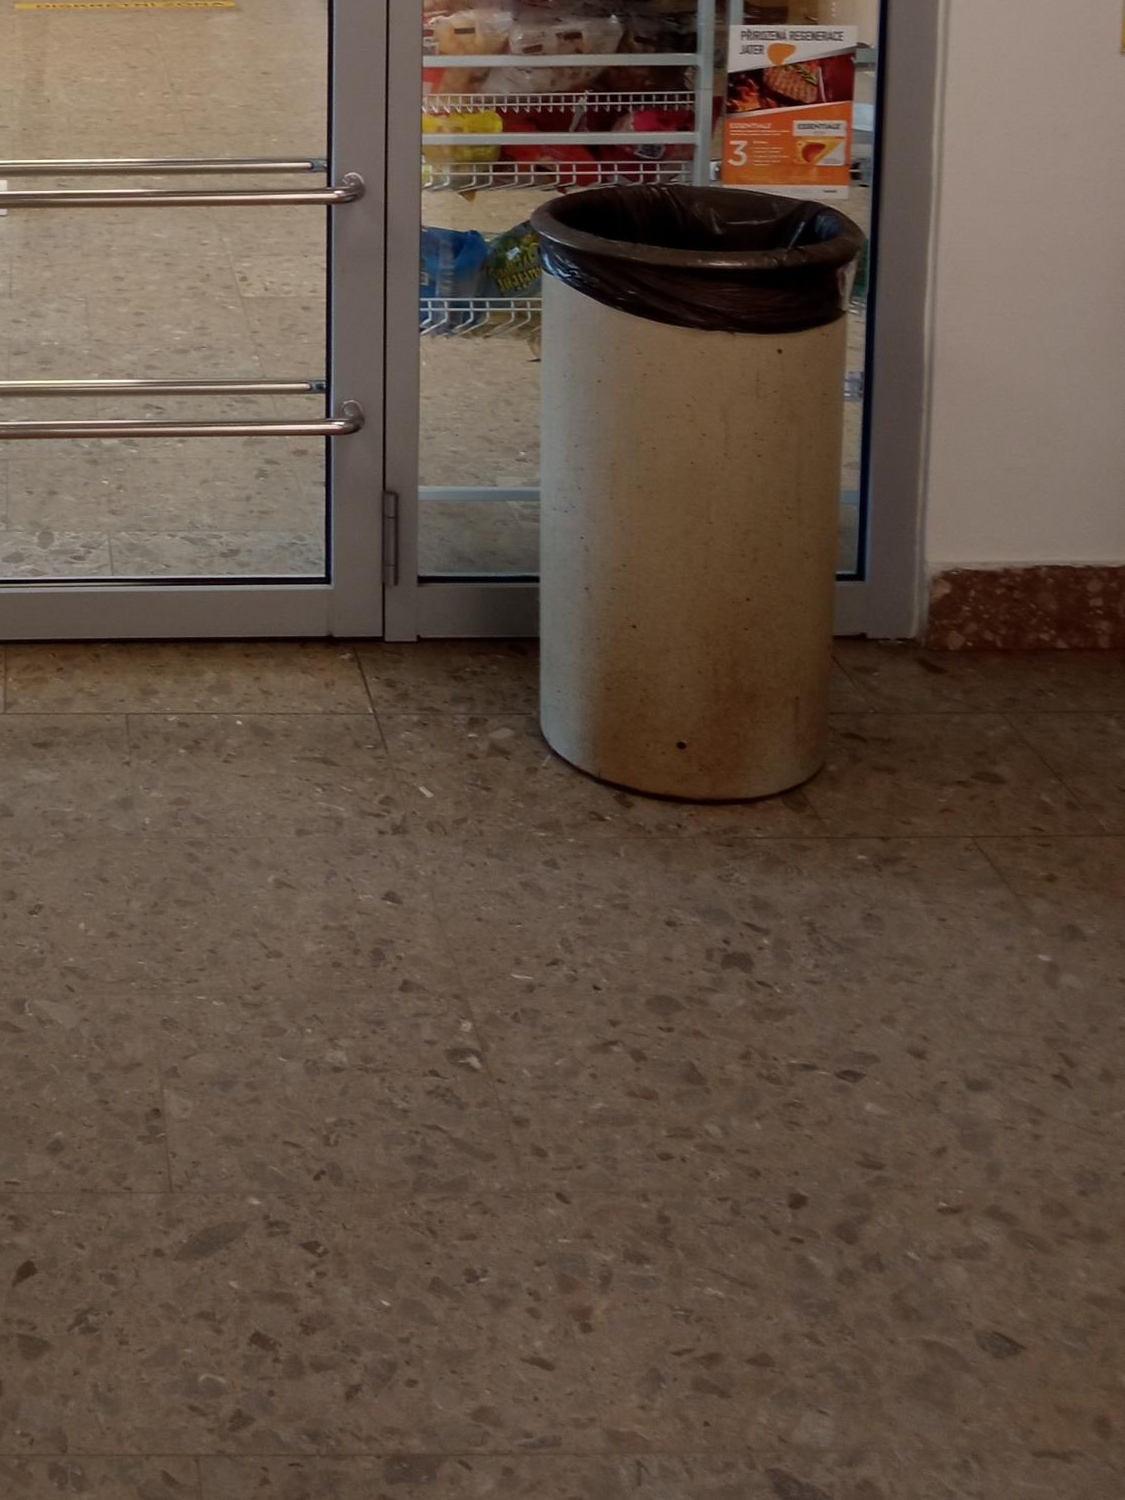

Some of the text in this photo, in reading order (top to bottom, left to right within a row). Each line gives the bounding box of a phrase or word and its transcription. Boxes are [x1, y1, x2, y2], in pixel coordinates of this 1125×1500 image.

[740, 29, 844, 41] PŘIROZENÁ REGENERACE
[739, 44, 765, 55] JATER
[728, 140, 748, 167] 3
